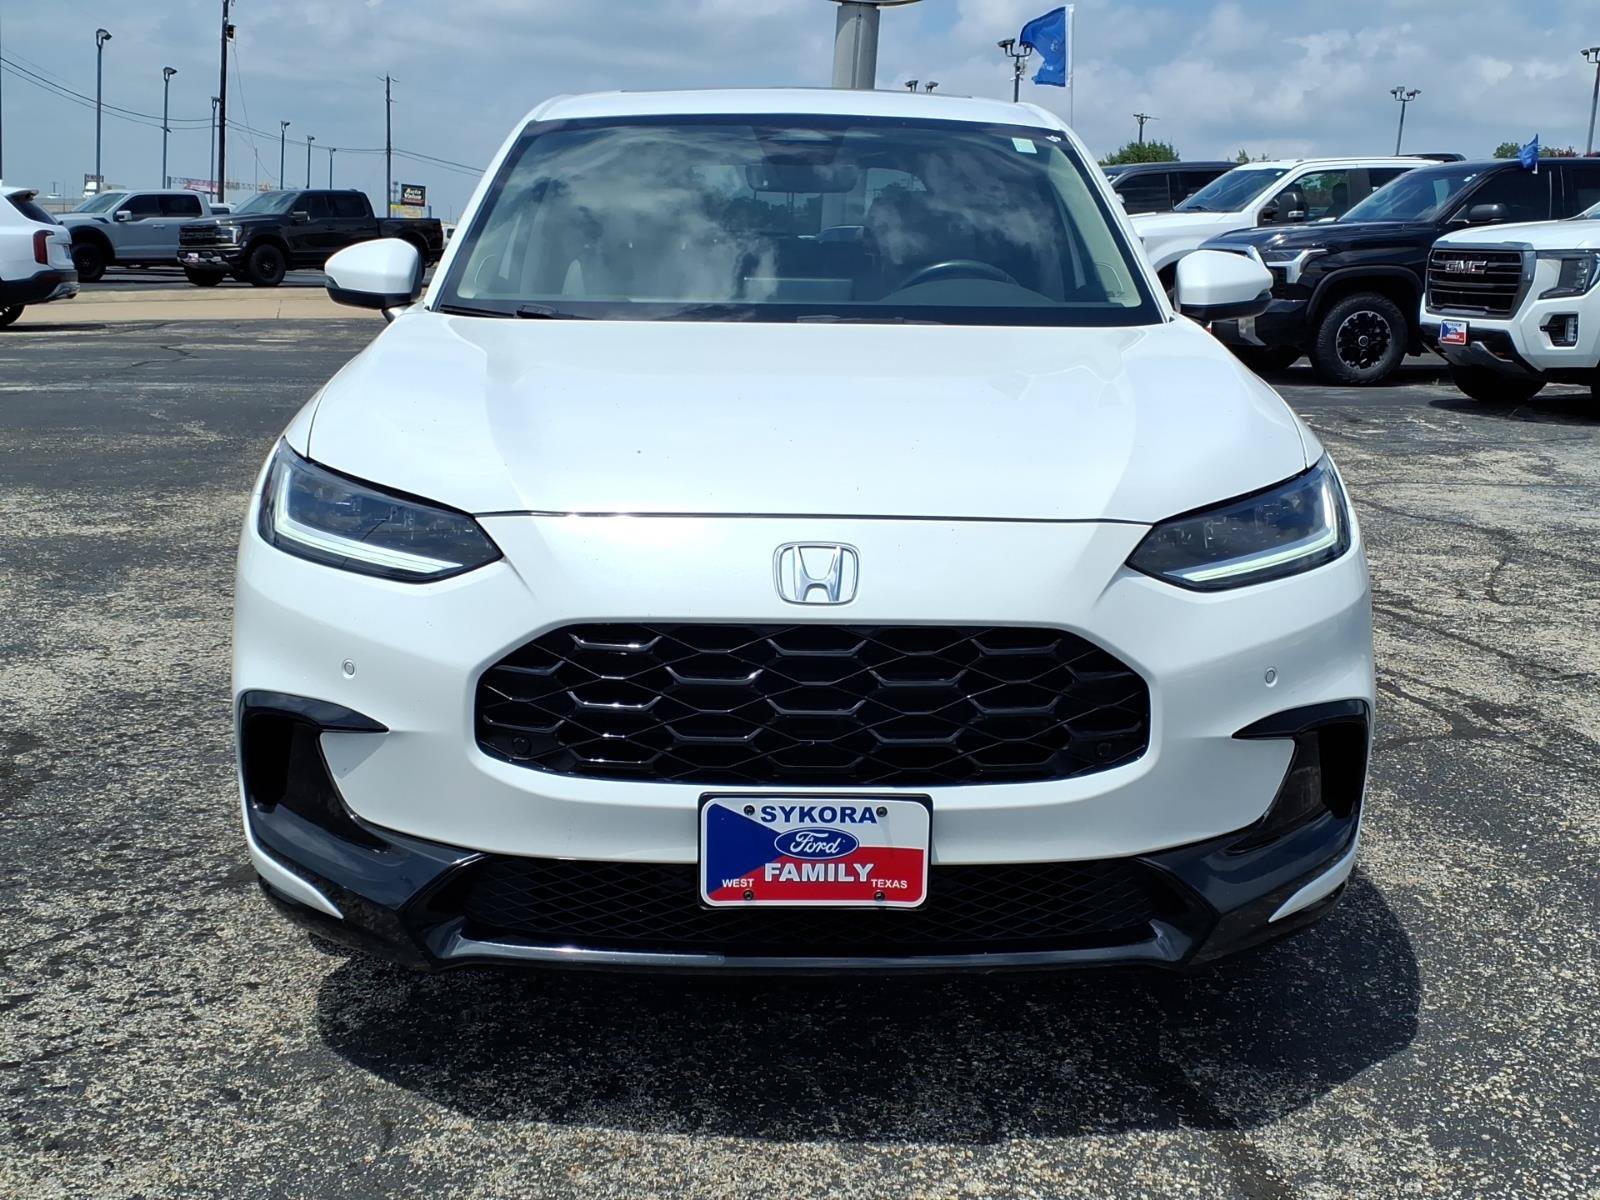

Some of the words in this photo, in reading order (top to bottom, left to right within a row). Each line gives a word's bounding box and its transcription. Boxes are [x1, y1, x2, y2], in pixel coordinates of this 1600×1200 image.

[1445, 260, 1487, 274] GMC
[760, 805, 877, 823] SYKORA
[789, 831, 842, 854] Ford
[764, 863, 874, 882] FAMILY
[722, 878, 754, 888] WEST
[870, 878, 908, 889] TEXAS
